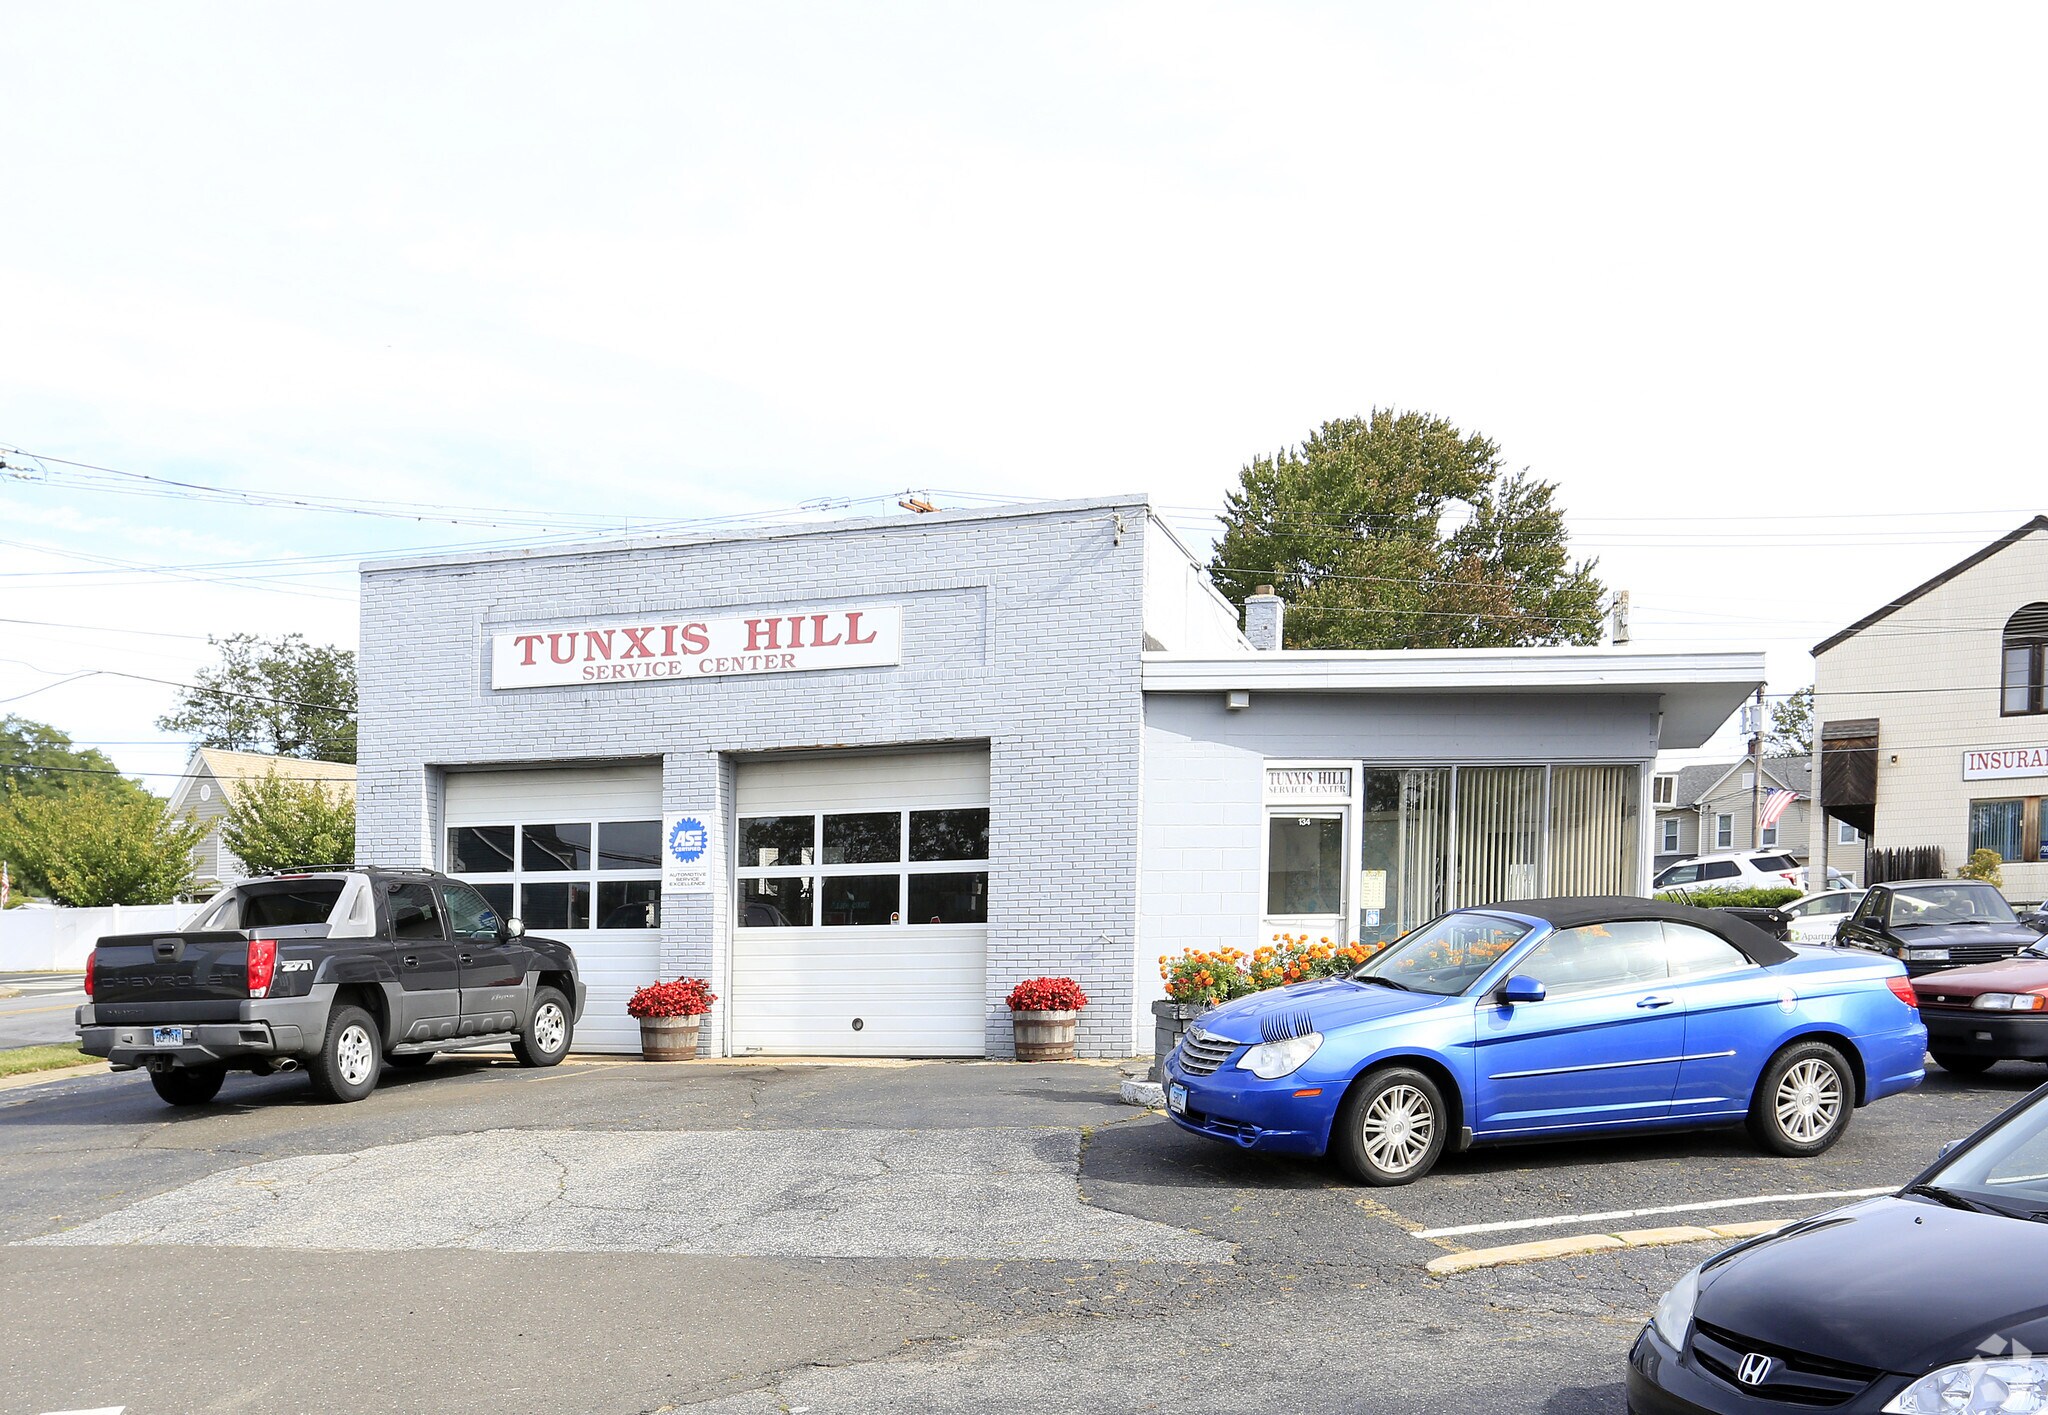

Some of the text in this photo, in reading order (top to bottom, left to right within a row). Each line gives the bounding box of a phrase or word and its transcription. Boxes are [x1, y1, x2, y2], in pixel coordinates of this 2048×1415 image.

[514, 612, 878, 666] TUNXIS HILL
[582, 653, 796, 681] SERVICE CENTER
[1968, 749, 2048, 771] INSURA
[1268, 771, 1347, 785] TUNXIS HILL
[1310, 785, 1346, 793] CENTER
[1297, 818, 1311, 826] 134
[673, 830, 702, 847] ASE
[281, 959, 314, 972] Z71
